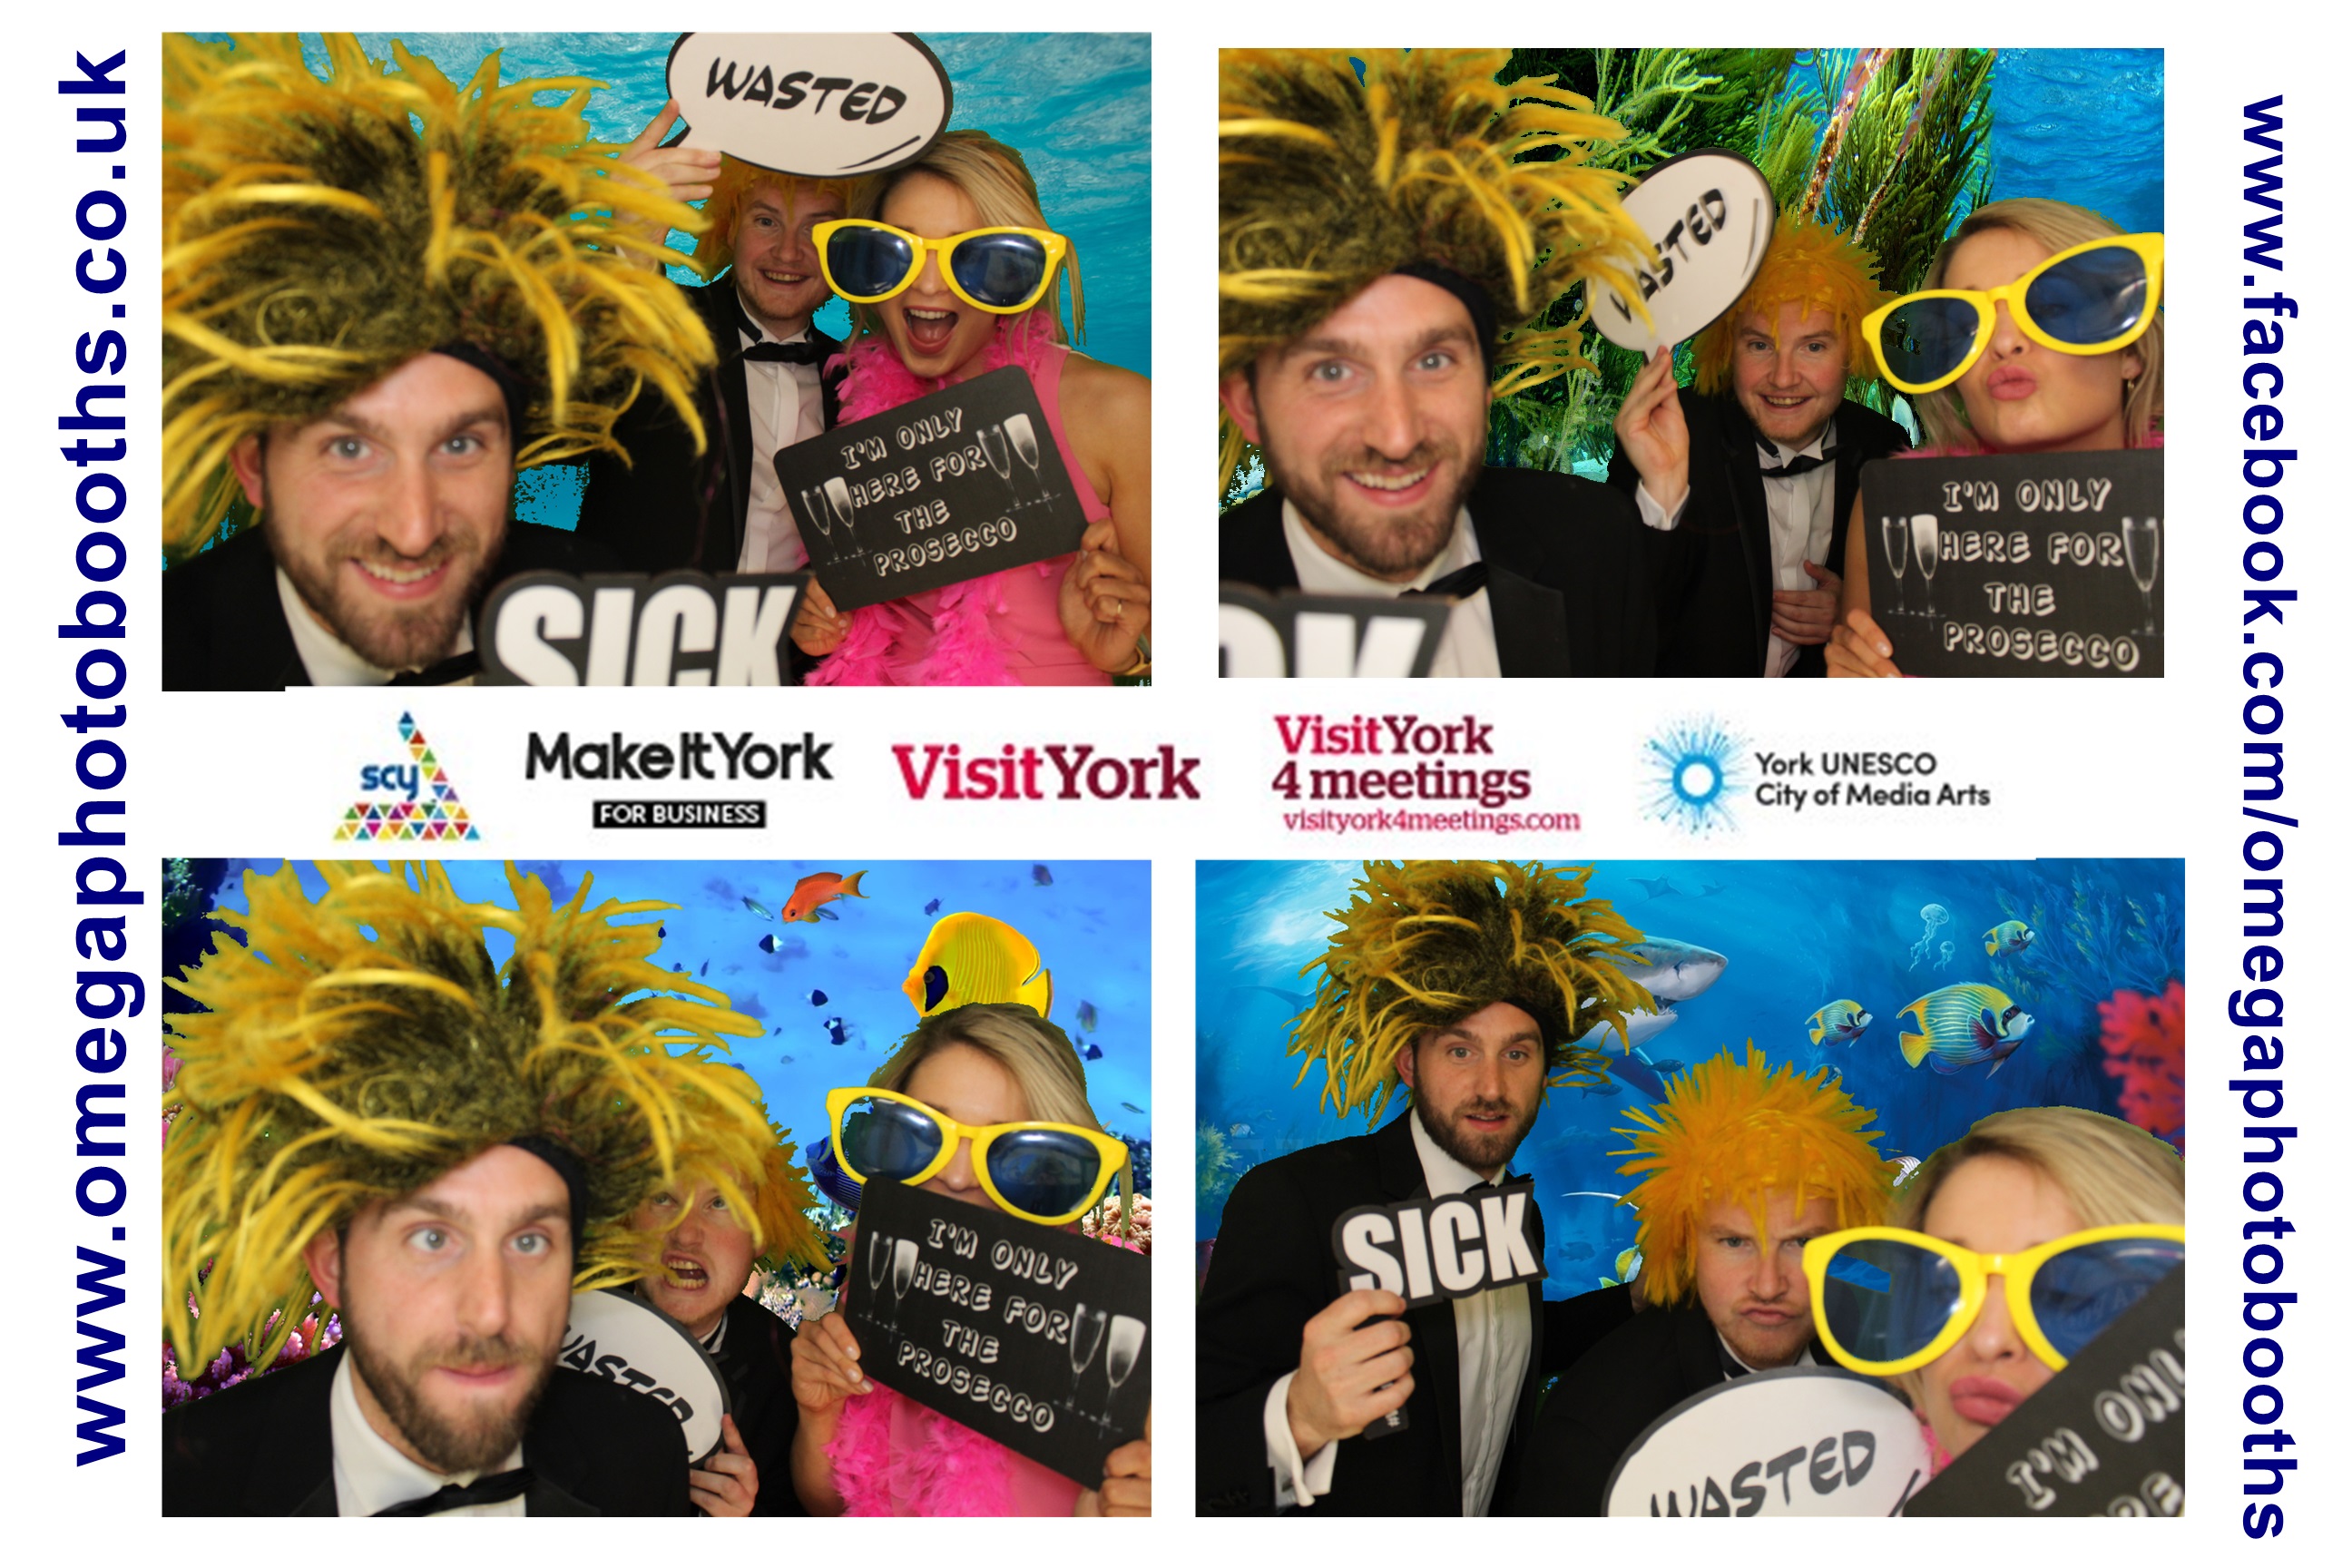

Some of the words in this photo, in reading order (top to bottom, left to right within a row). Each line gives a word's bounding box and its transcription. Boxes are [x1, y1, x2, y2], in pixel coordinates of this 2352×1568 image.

[706, 56, 906, 125] WASTED
[841, 436, 887, 469] I'M
[897, 407, 963, 450] ONLY
[848, 466, 921, 508] HERE
[929, 445, 987, 483] FOR
[1942, 481, 1999, 513] I'M
[2015, 477, 2112, 513] ONLY
[873, 516, 1018, 577] PROSECCO
[894, 499, 950, 534] THE
[1938, 531, 2031, 564] HERE
[2047, 532, 2124, 567] FOR
[1983, 582, 2056, 616] THE
[1943, 621, 2140, 672] PROSECCO
[927, 1219, 978, 1259] I'M
[991, 1240, 1078, 1290] ONLY
[1342, 1192, 1539, 1299] SICK
[913, 1260, 993, 1311] HERE
[1004, 1295, 1071, 1345] FOR
[942, 1318, 1000, 1364] THE
[897, 1340, 1055, 1433] PROSECCO
[2005, 1427, 2100, 1511] I'M
